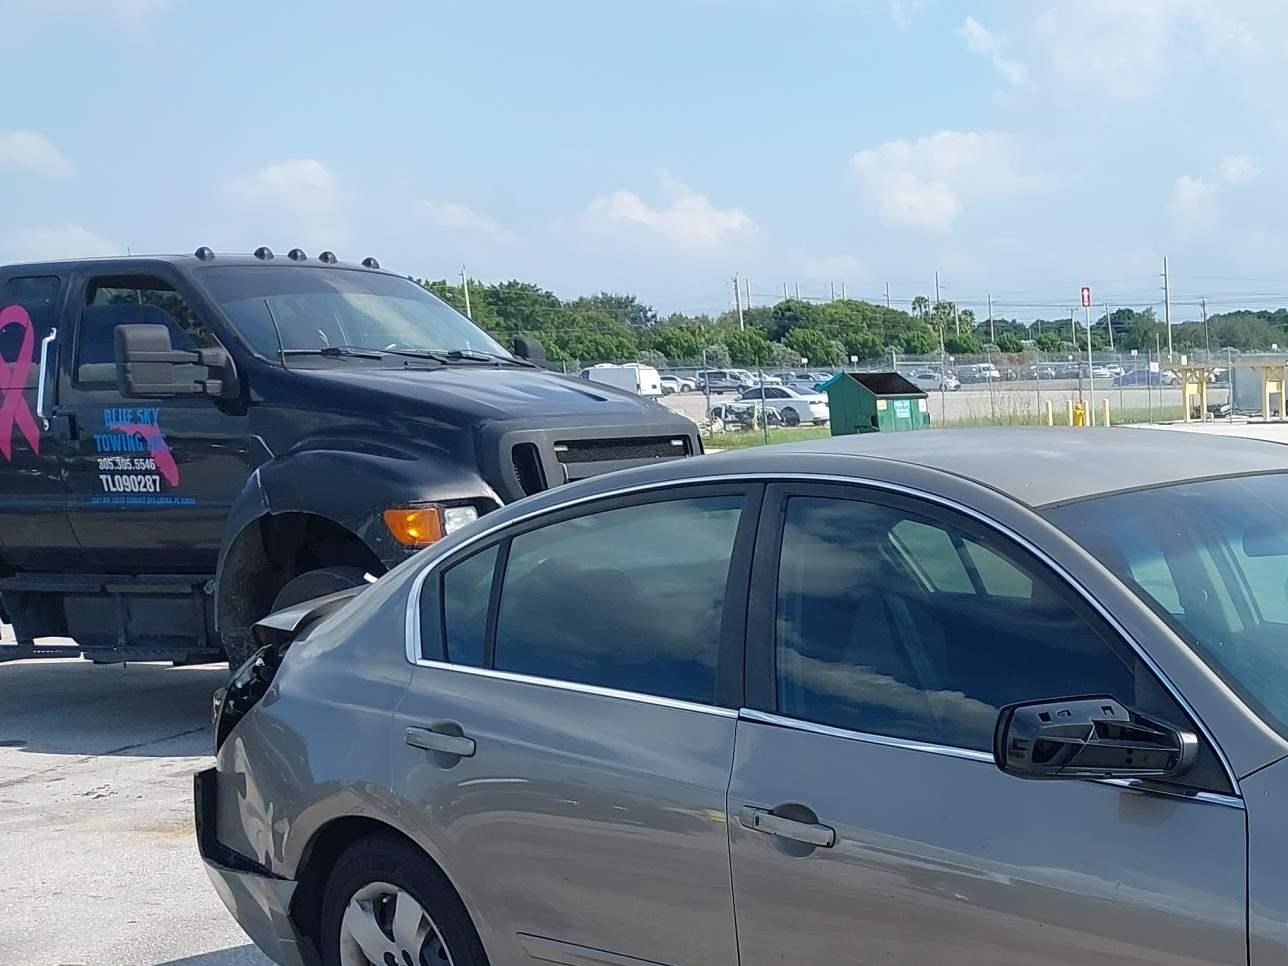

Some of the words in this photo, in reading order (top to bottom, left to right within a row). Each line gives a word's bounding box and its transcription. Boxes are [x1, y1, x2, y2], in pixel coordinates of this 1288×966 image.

[104, 408, 133, 426] BLUE
[137, 407, 160, 425] SKY
[94, 433, 144, 452] TOWING
[98, 457, 156, 470] 305.305.5546
[99, 475, 160, 492] TL090287
